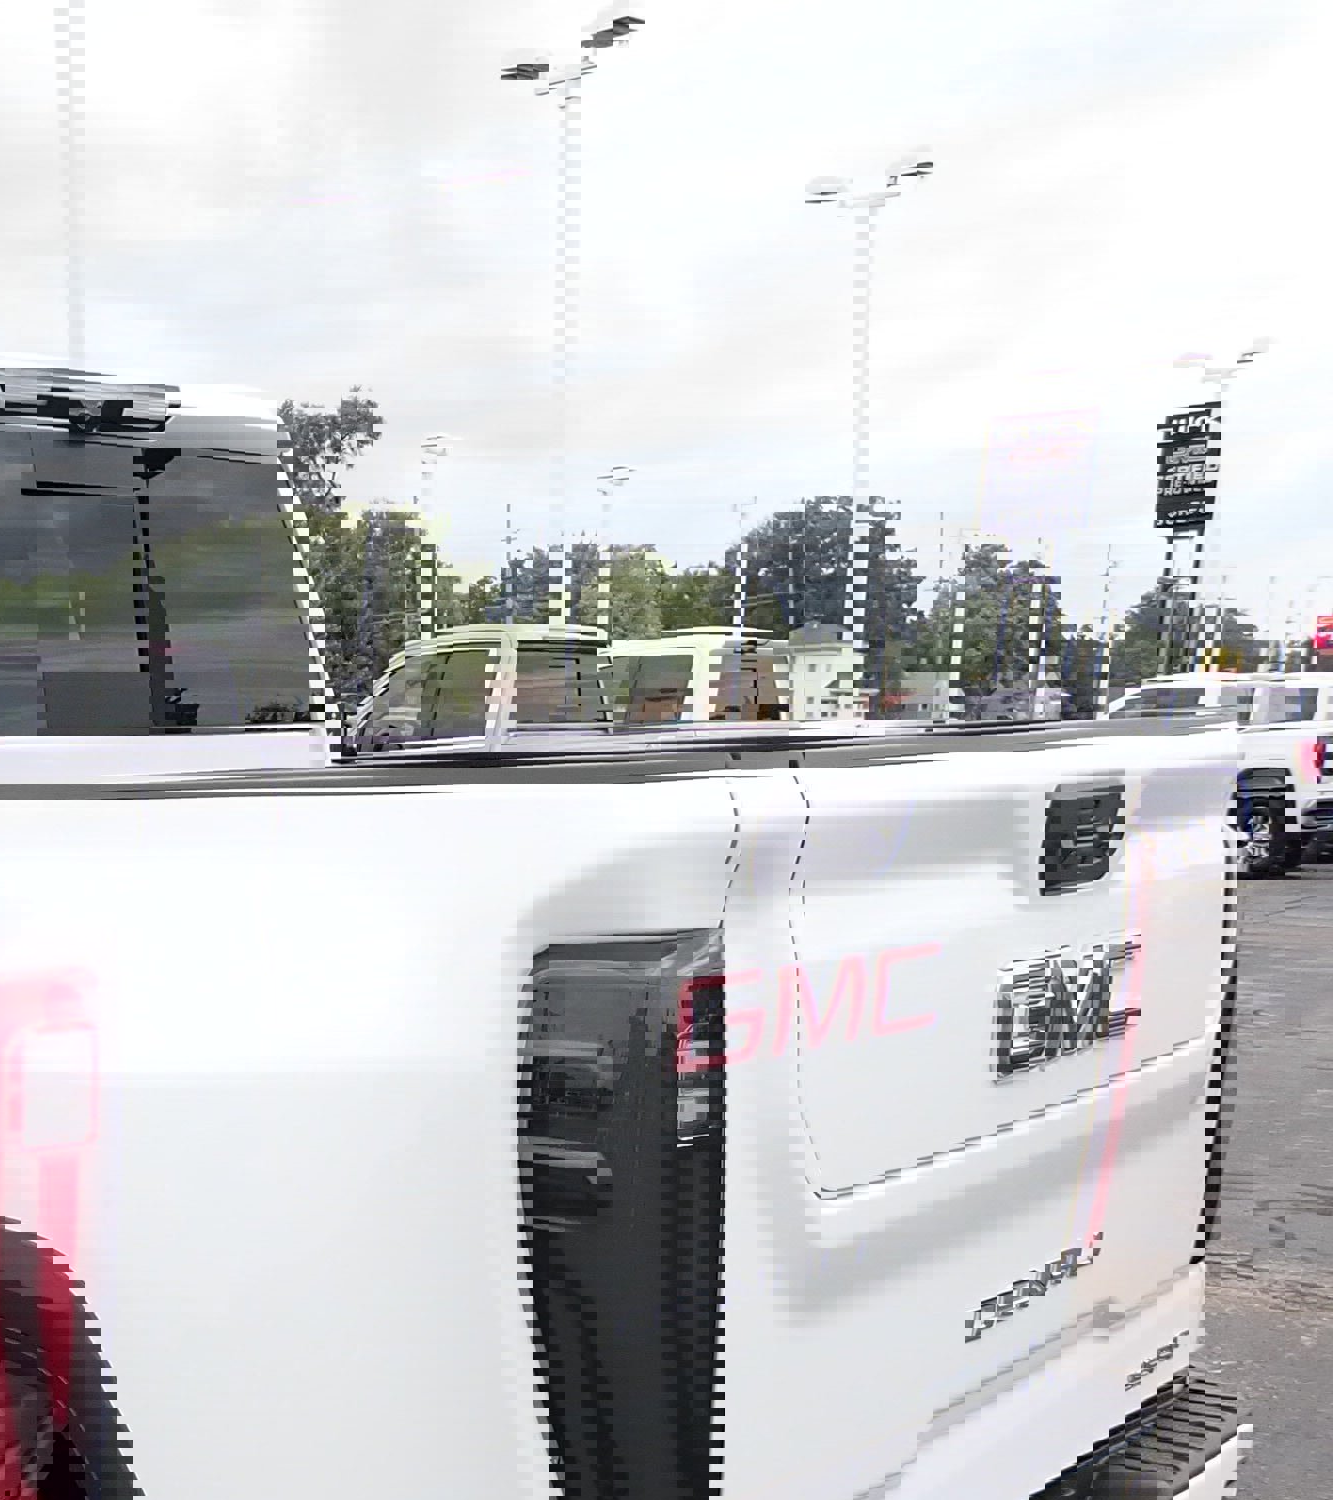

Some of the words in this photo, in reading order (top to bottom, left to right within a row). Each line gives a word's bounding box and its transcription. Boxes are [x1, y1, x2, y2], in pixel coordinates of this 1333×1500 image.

[994, 420, 1096, 443] BUICK
[1005, 443, 1083, 466] GMC
[990, 468, 1091, 486] CERTIFIED
[993, 481, 1086, 497] PRE-OWNED
[991, 508, 1082, 526] SCHEPEL
[654, 934, 942, 1086] GMC
[603, 1234, 864, 1346] DENALI
[918, 1335, 1033, 1395] SIERRA
